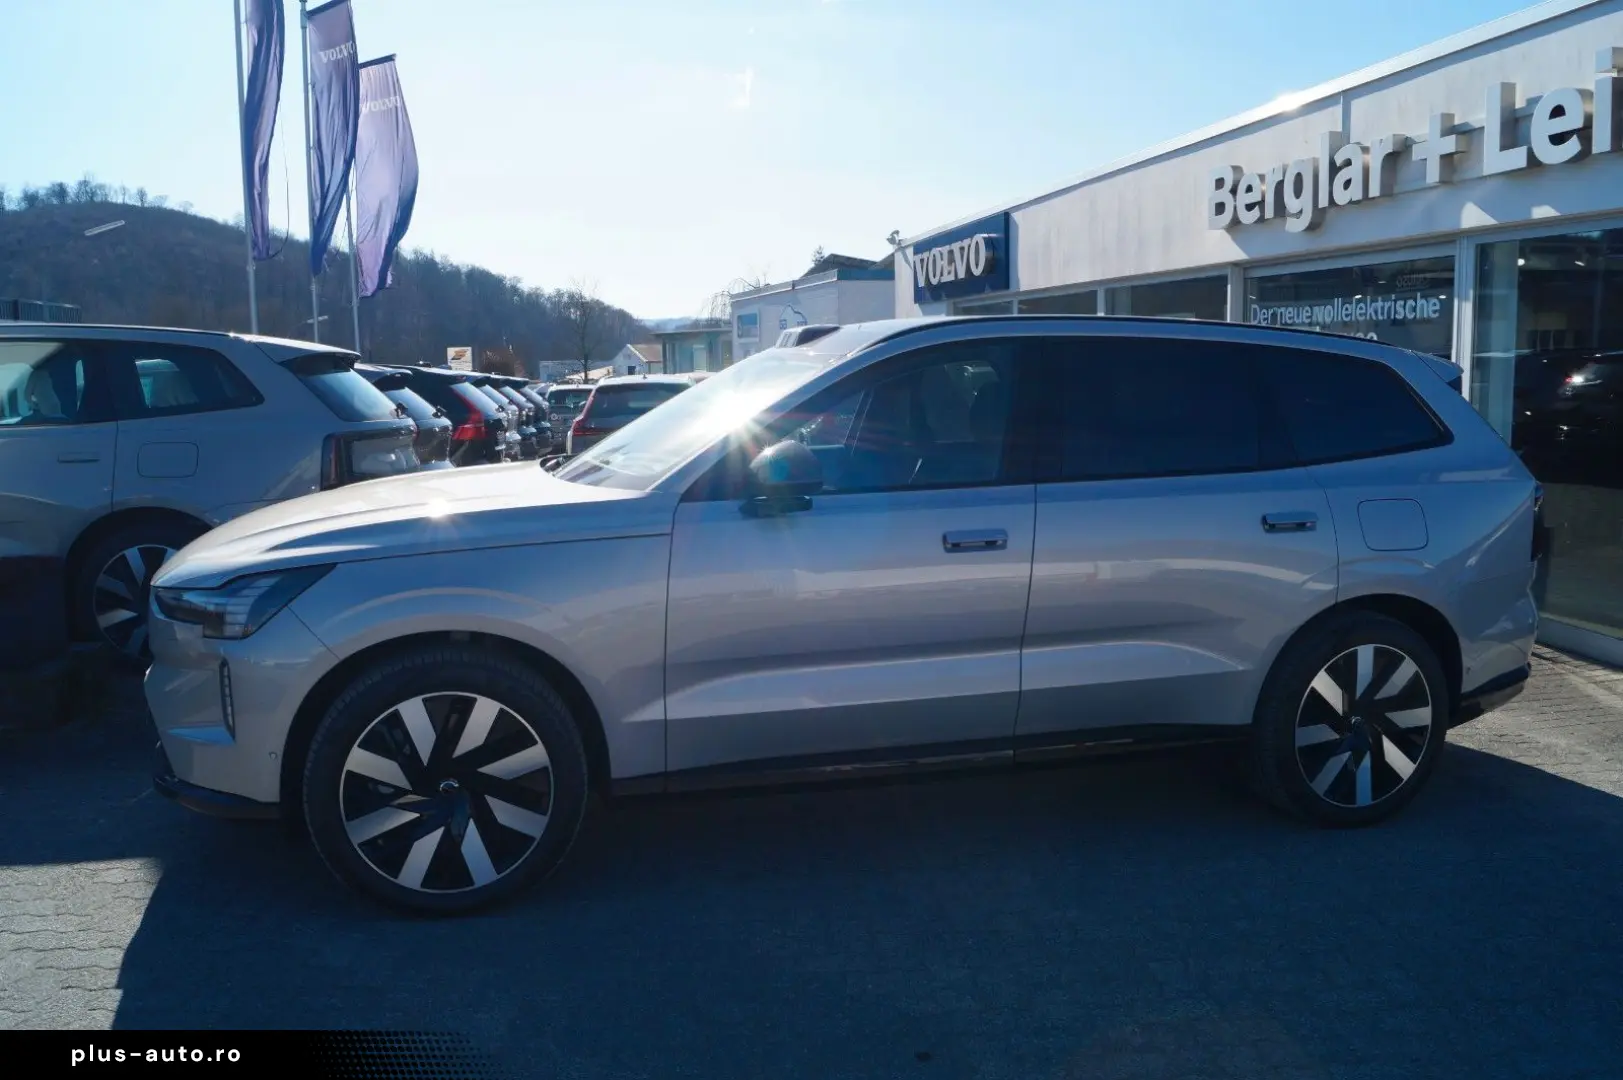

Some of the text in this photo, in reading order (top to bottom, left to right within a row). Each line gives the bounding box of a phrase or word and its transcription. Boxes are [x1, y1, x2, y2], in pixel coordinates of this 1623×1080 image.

[1208, 131, 1404, 233] Berglar
[1412, 113, 1462, 184] +
[913, 233, 986, 288] VOLVO
[1251, 293, 1440, 326] Der neue vollelektrische
